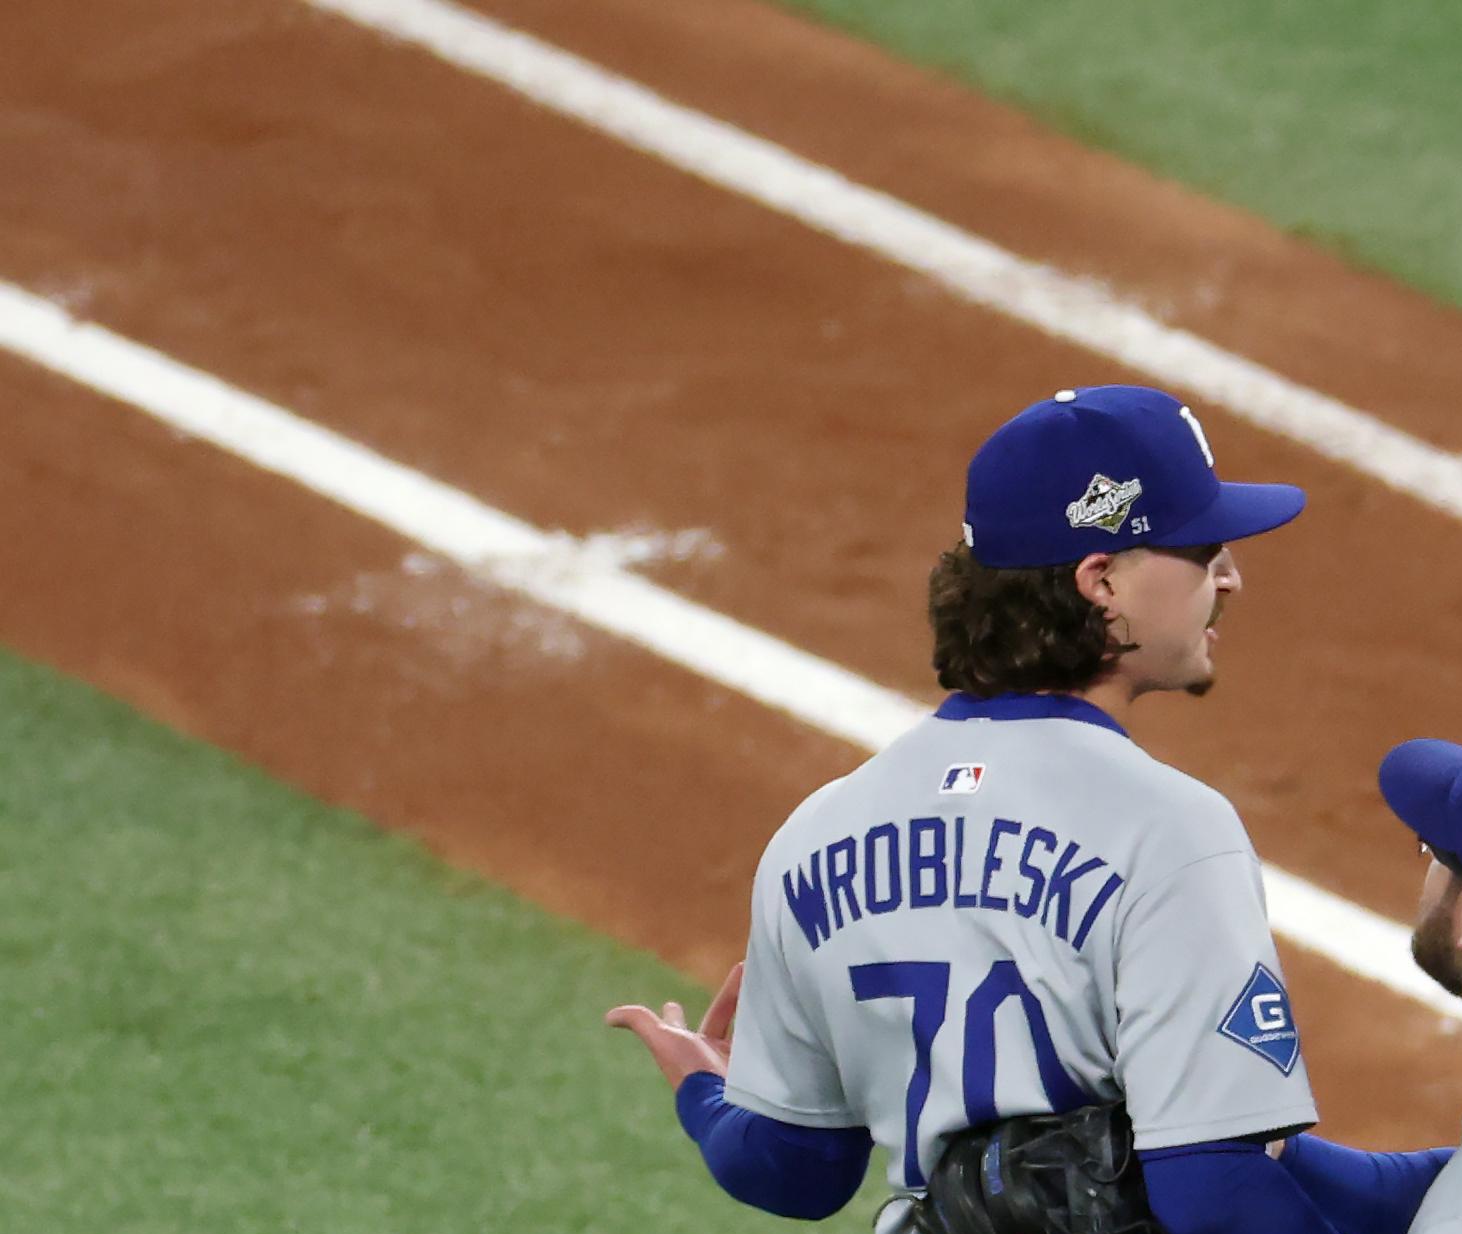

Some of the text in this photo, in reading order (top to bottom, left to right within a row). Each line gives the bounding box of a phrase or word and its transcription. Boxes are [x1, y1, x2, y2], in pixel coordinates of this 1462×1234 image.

[1130, 515, 1151, 534] 51
[782, 816, 1125, 952] WROBLESKI
[1251, 993, 1286, 1030] G
[848, 960, 1105, 1188] 70
